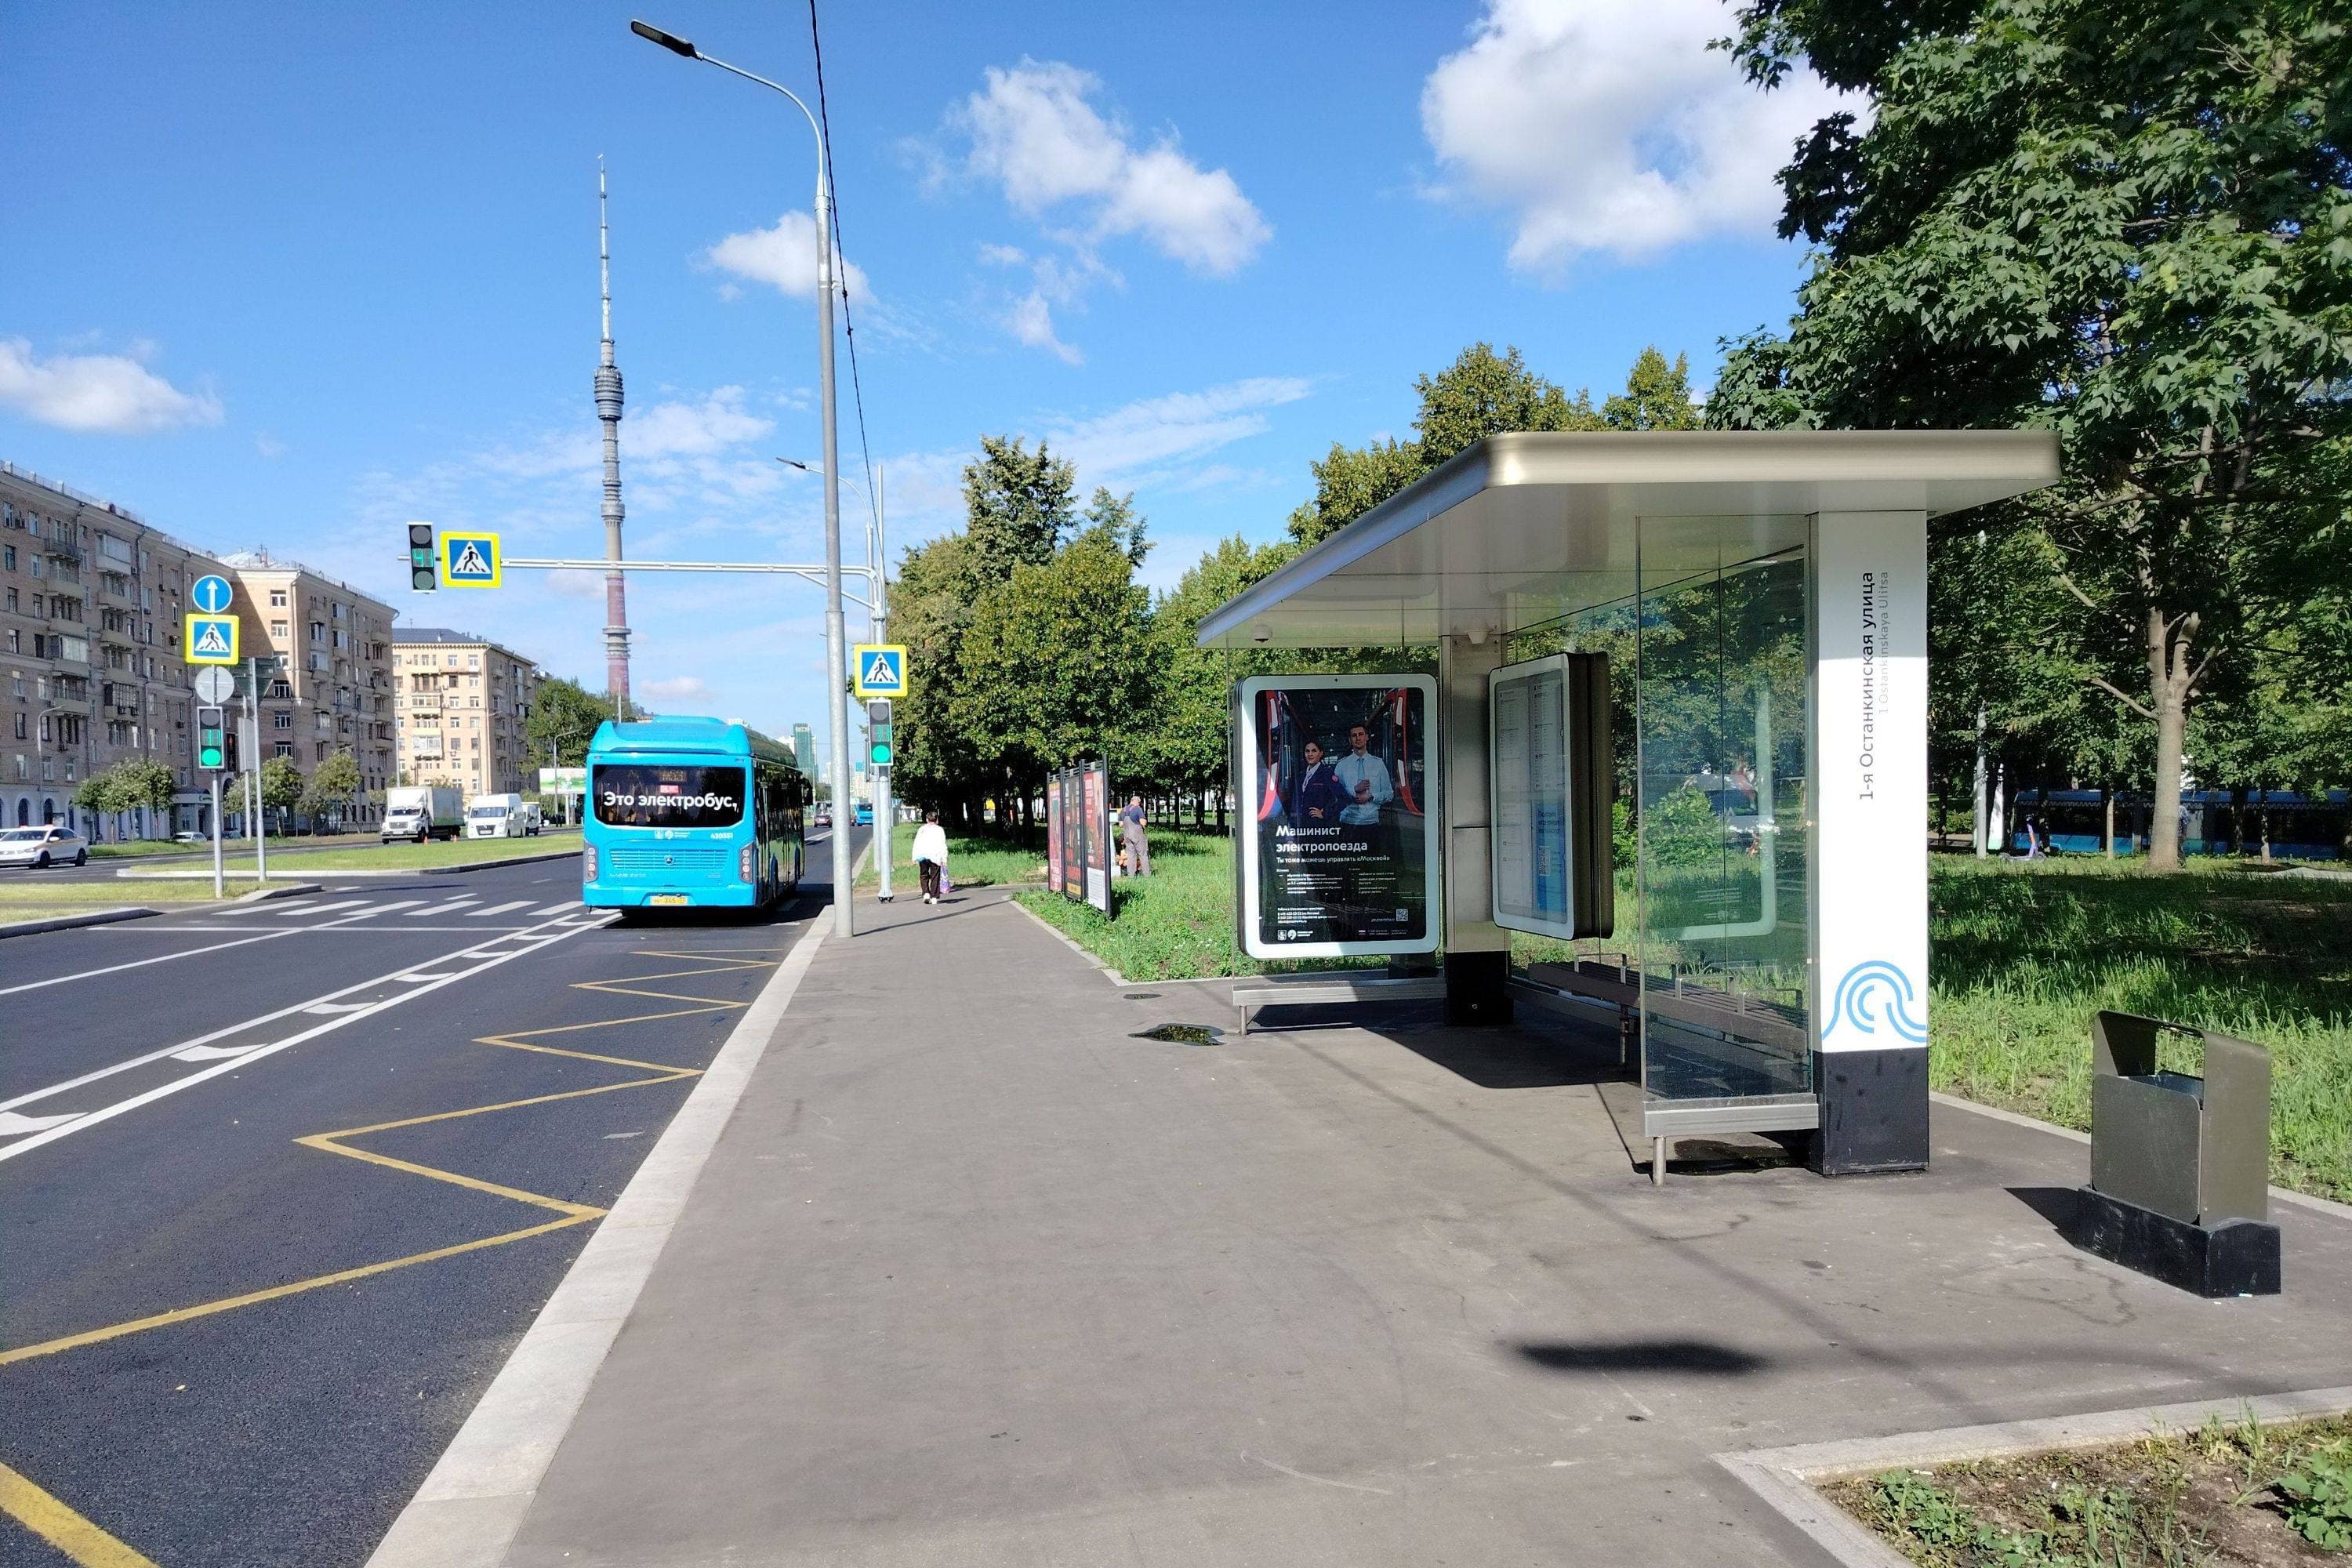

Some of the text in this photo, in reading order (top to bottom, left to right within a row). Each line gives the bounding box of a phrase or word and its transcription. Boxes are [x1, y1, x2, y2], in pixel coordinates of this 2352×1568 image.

[1878, 572, 1889, 608] Ulitsa
[1878, 612, 1890, 704] Ostankinskaya
[1859, 572, 1876, 800] 1-я Останкинская улица
[604, 792, 738, 811] Это электробус,
[1276, 826, 1341, 836] Машинист
[1276, 842, 1367, 853] электропоезда
